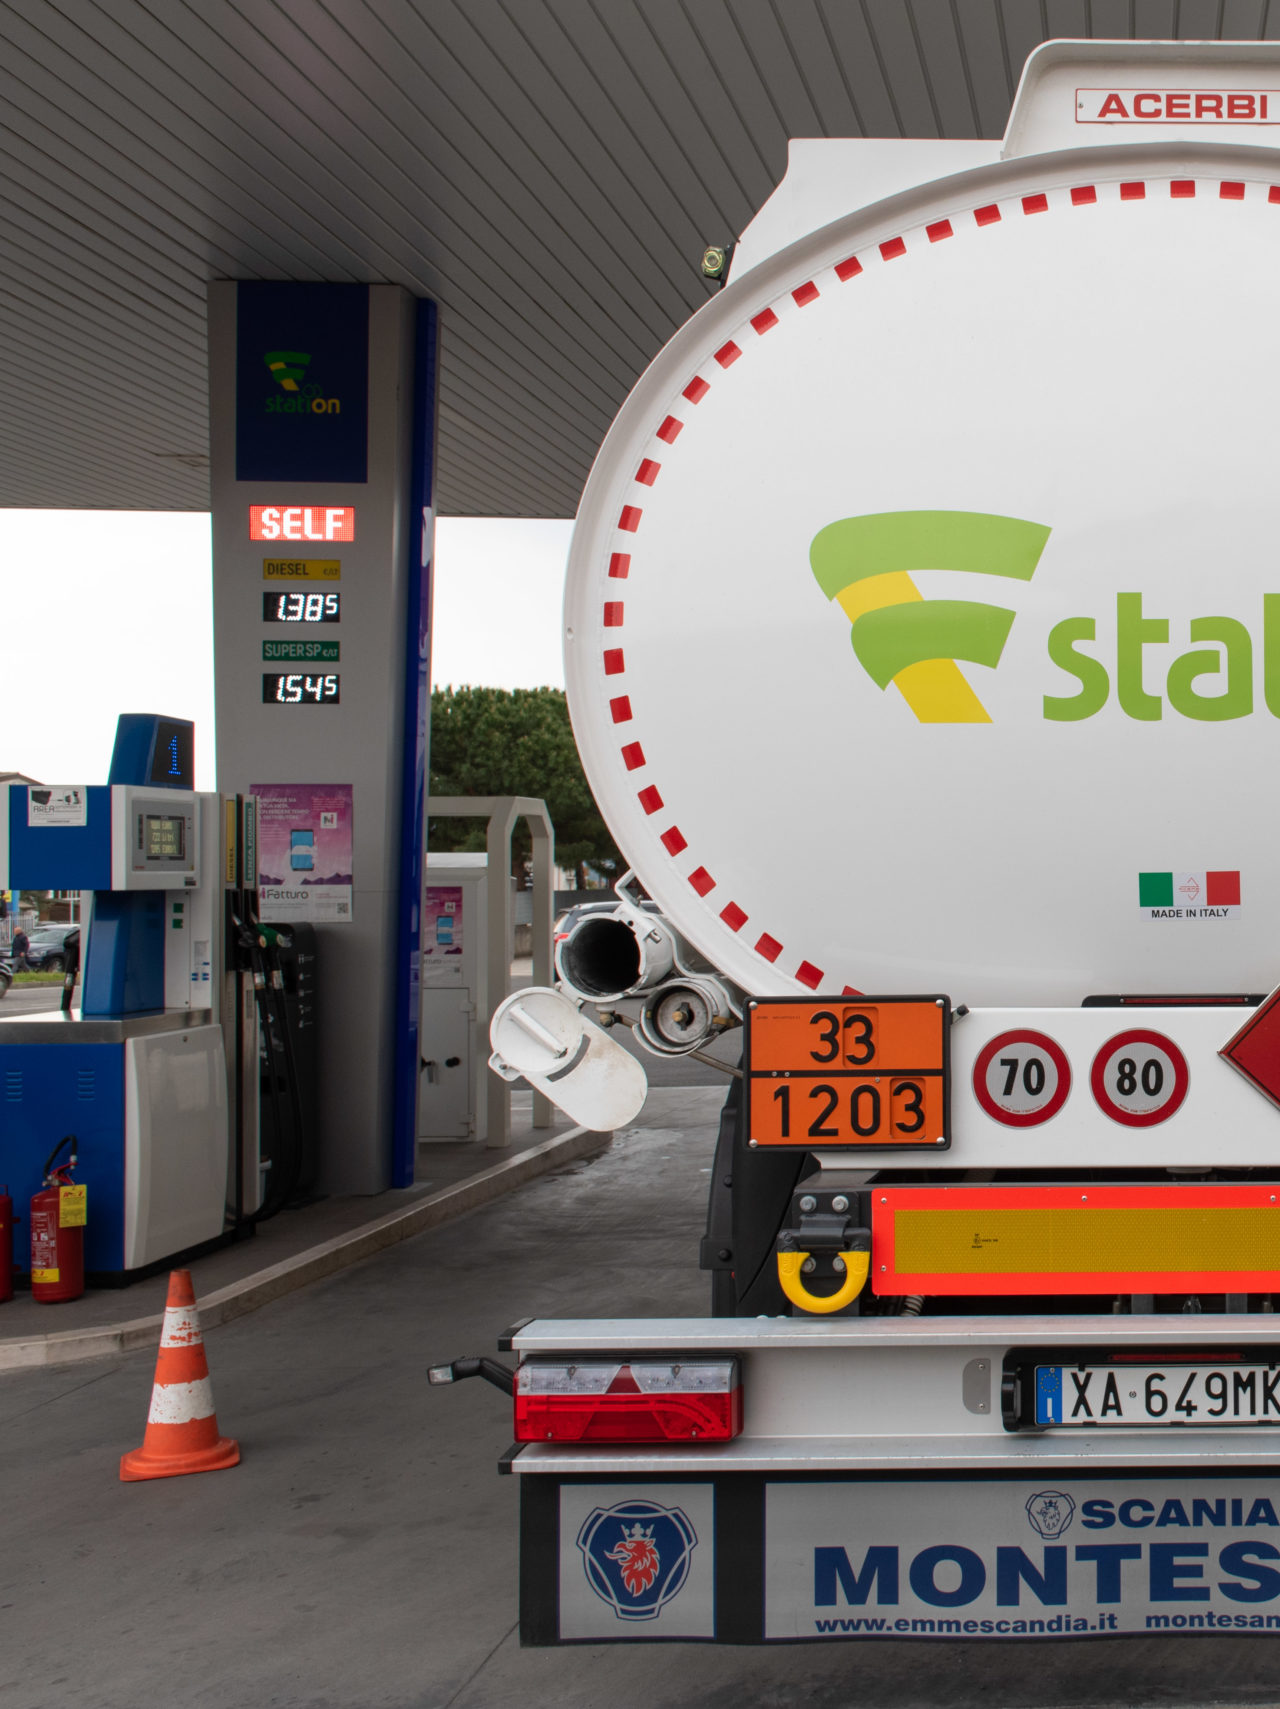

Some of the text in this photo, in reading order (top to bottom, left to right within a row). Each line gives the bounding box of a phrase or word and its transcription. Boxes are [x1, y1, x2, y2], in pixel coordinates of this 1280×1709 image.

[1097, 93, 1268, 119] ACERBI
[264, 394, 341, 414] station
[261, 508, 345, 540] SELF
[267, 562, 309, 576] DIESEL
[265, 643, 304, 657] SUPER
[305, 643, 321, 657] SP
[168, 735, 181, 776] 1
[1151, 908, 1229, 919] MADE IN ITALY
[809, 1010, 876, 1066] 33
[999, 1058, 1046, 1096] 70
[1115, 1057, 1165, 1097] 80
[773, 1081, 926, 1138] 1203
[1080, 1498, 1280, 1529] SCANIA
[815, 1613, 1118, 1634] www.emmescandia.it
